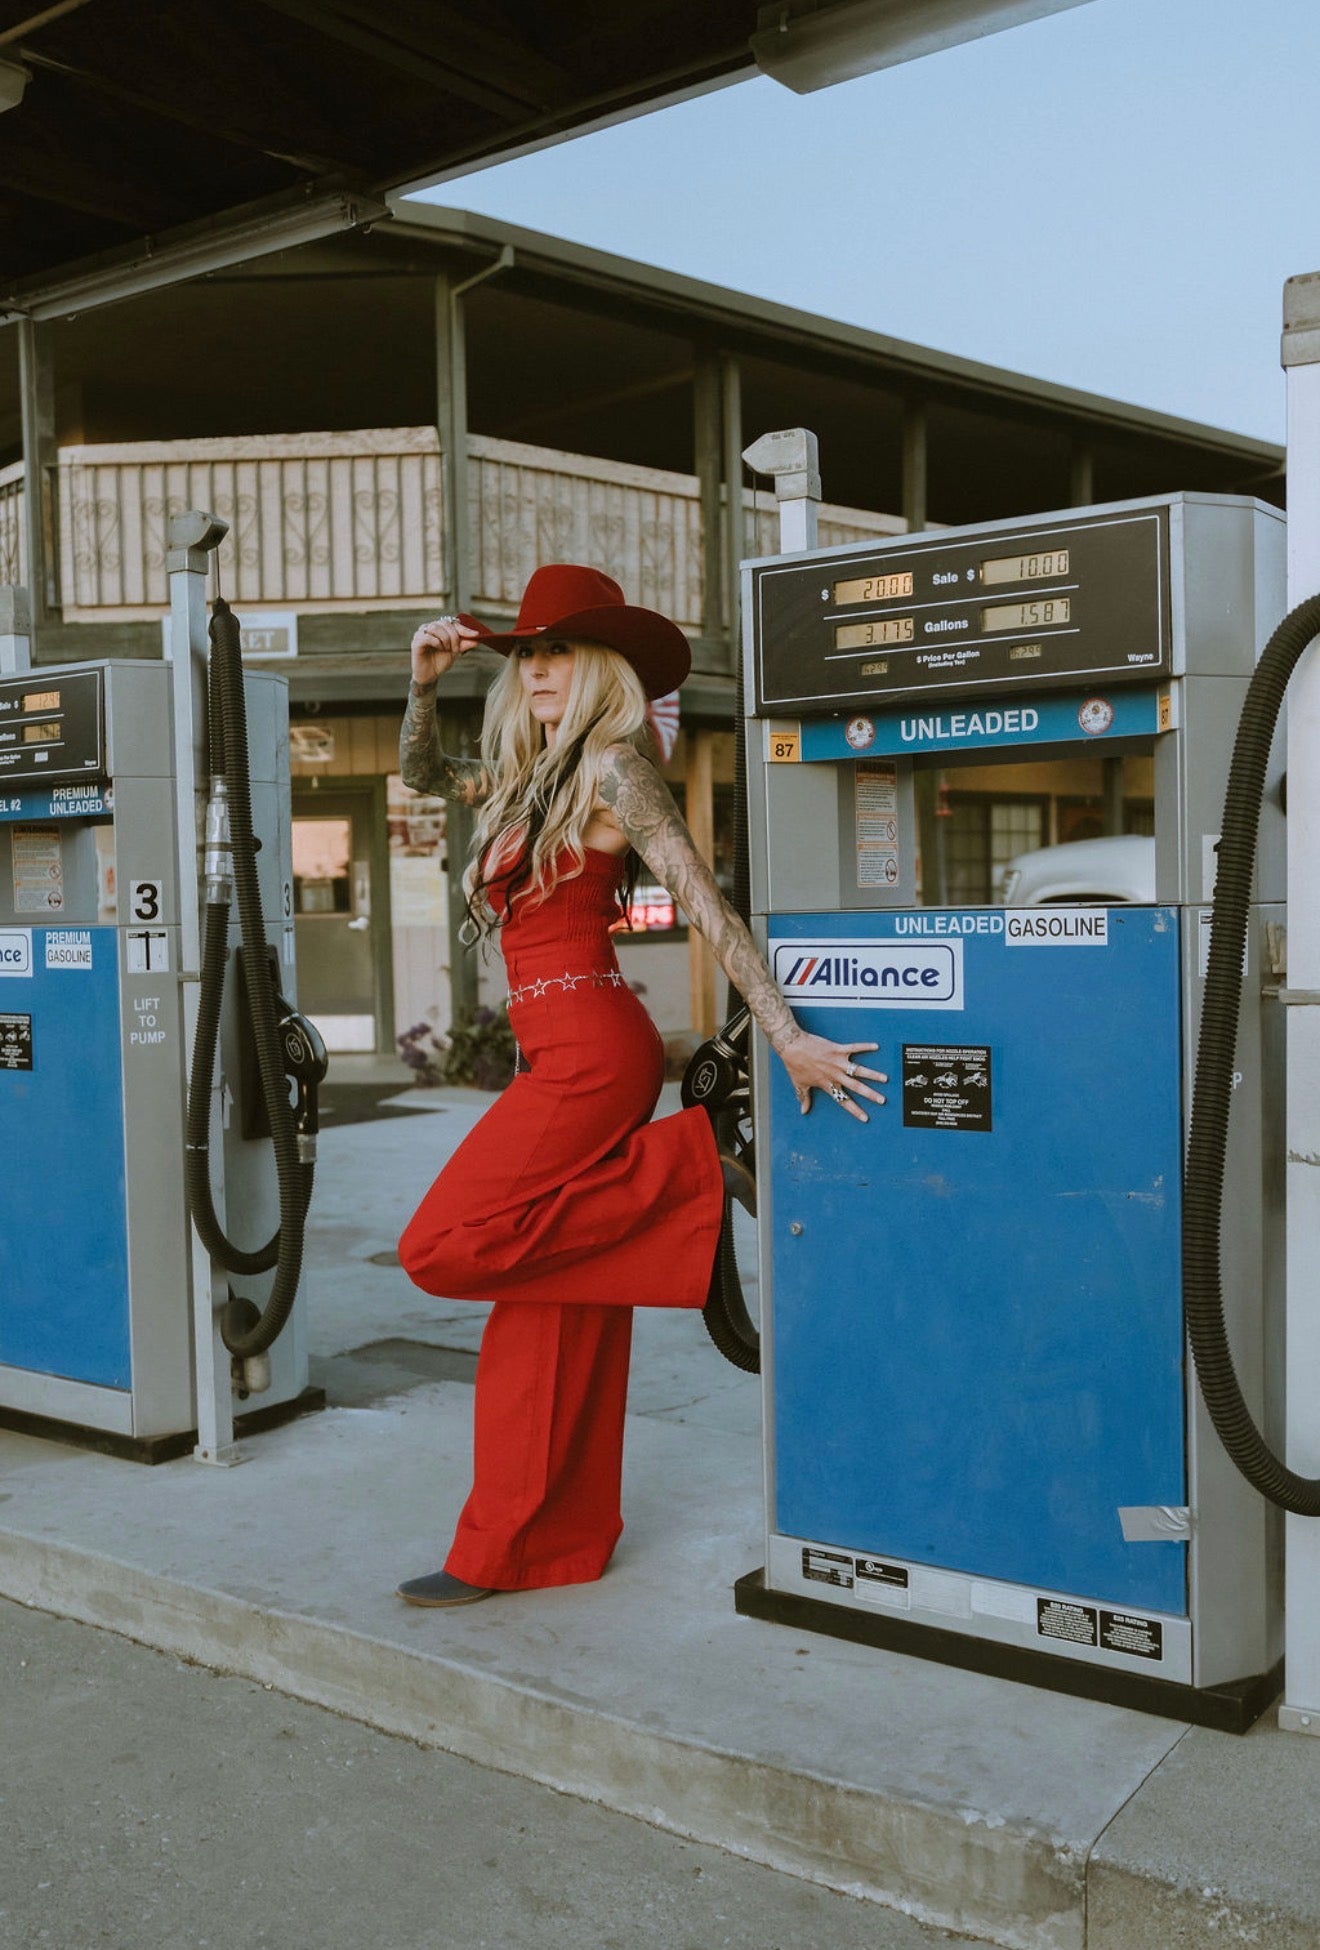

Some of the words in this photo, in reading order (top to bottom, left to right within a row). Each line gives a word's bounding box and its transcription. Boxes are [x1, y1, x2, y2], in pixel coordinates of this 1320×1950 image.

[1018, 553, 1069, 578] 10.00
[932, 573, 958, 585] Sale
[966, 568, 975, 580] $
[821, 589, 829, 601] $
[863, 575, 913, 599] 20.00
[1018, 600, 1070, 625] 1.587
[865, 620, 913, 644] 3.175
[924, 618, 968, 633] Gallons
[957, 650, 980, 660] Gallon
[1128, 652, 1154, 664] Wayne
[900, 708, 1039, 741] UNLEADED
[775, 742, 794, 758] 87
[53, 786, 98, 801] PREMIUM
[10, 798, 21, 811] #2
[49, 800, 103, 815] UNLEADED
[135, 882, 158, 920] 3
[284, 883, 291, 918] 3
[895, 915, 1003, 935] UNLEADED
[1008, 916, 1106, 937] GASOLINE
[46, 932, 91, 945] PREMIUM
[47, 949, 91, 963] GASOLINE
[811, 959, 940, 988] Alliance
[134, 997, 160, 1012] LIFT
[138, 1015, 157, 1028] TO
[130, 1030, 166, 1045] PUMP
[694, 1066, 713, 1092] VST
